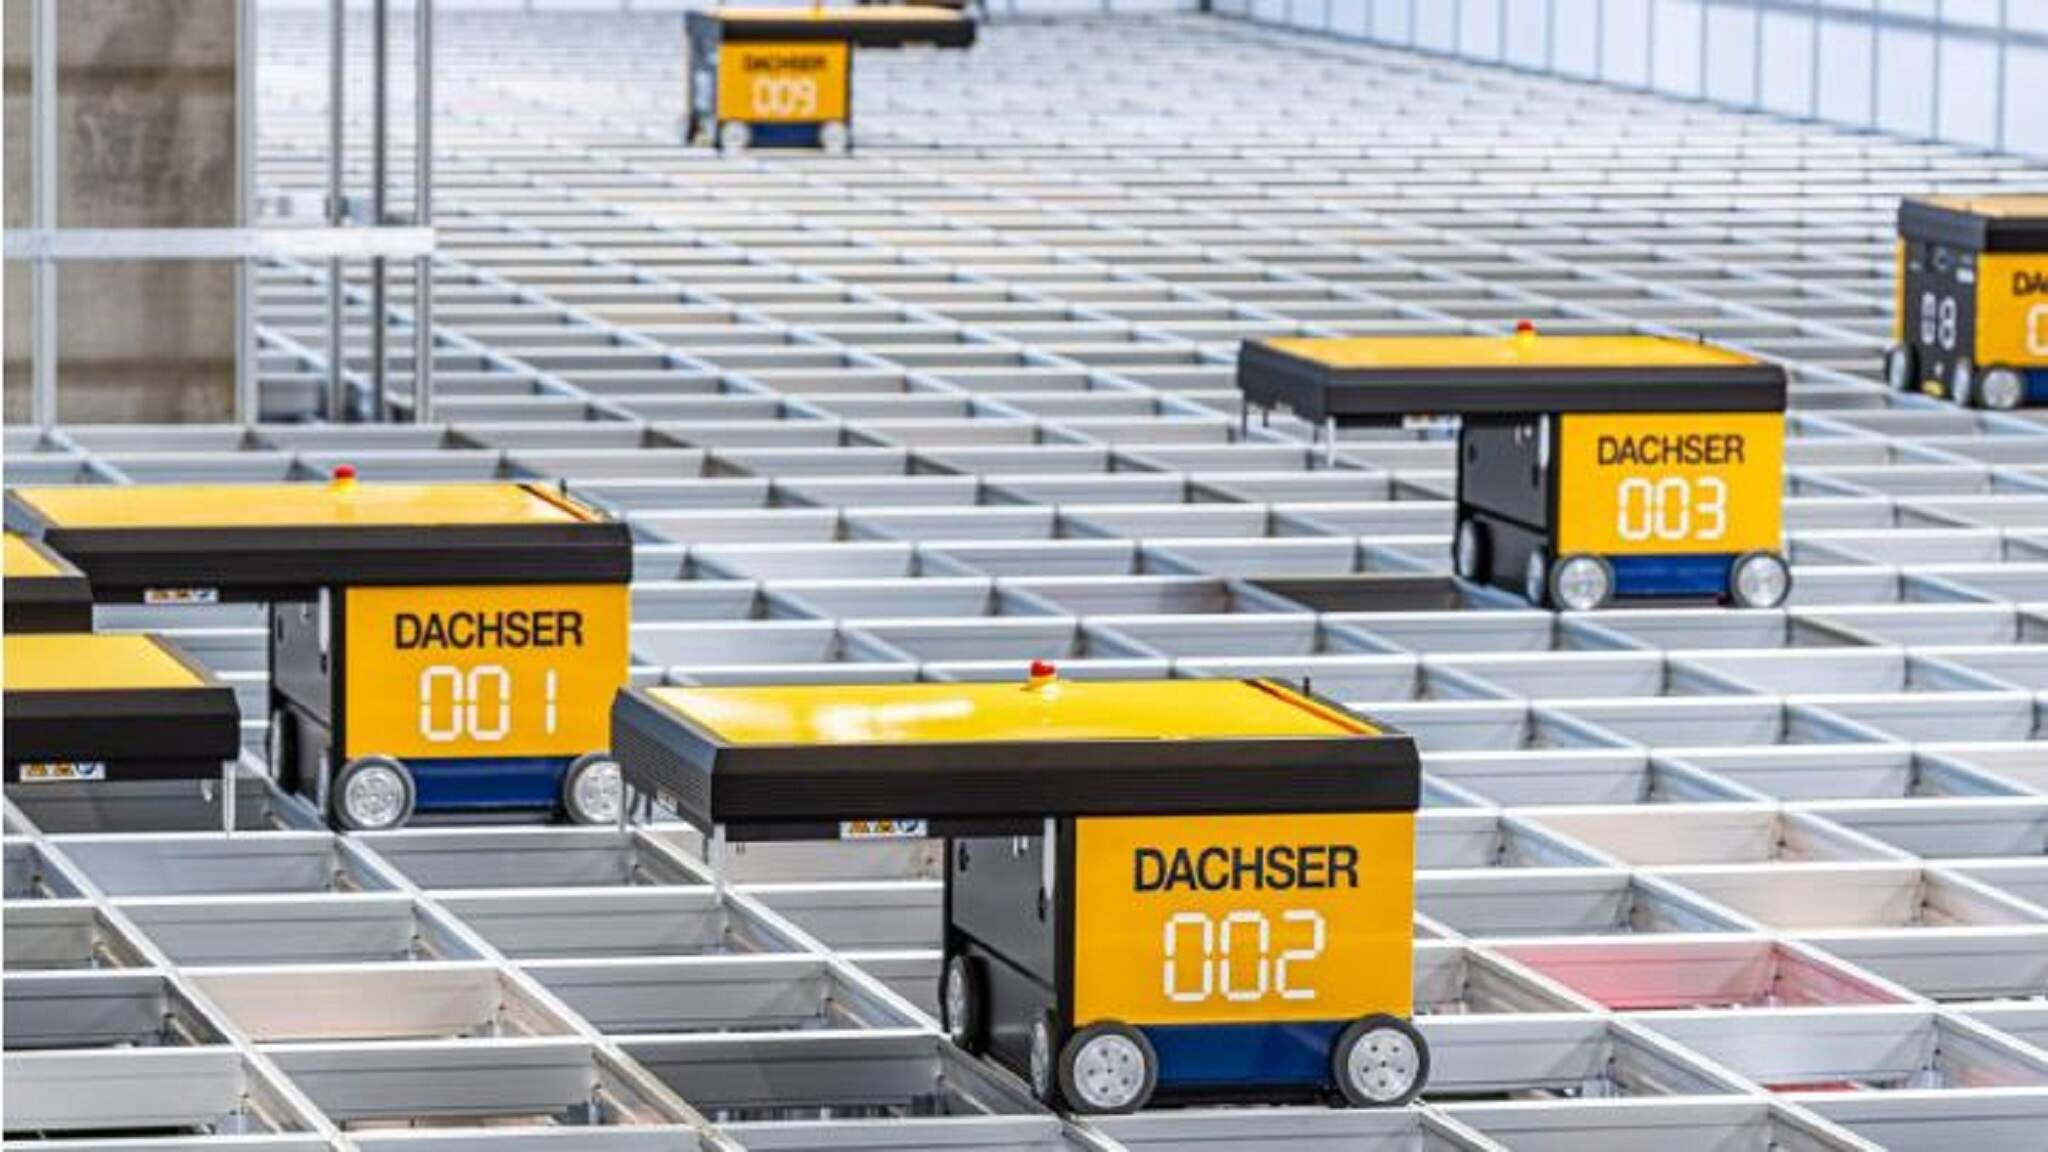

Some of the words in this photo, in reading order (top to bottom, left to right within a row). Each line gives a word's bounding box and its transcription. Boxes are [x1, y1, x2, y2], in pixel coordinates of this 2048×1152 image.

[752, 75, 817, 116] 009
[1598, 434, 1744, 465] DACHSER
[1617, 476, 1726, 541] 003
[395, 611, 583, 649] DACHSER
[418, 665, 556, 742] 001
[1133, 846, 1359, 892] DACHSER
[1162, 909, 1325, 1004] 002
